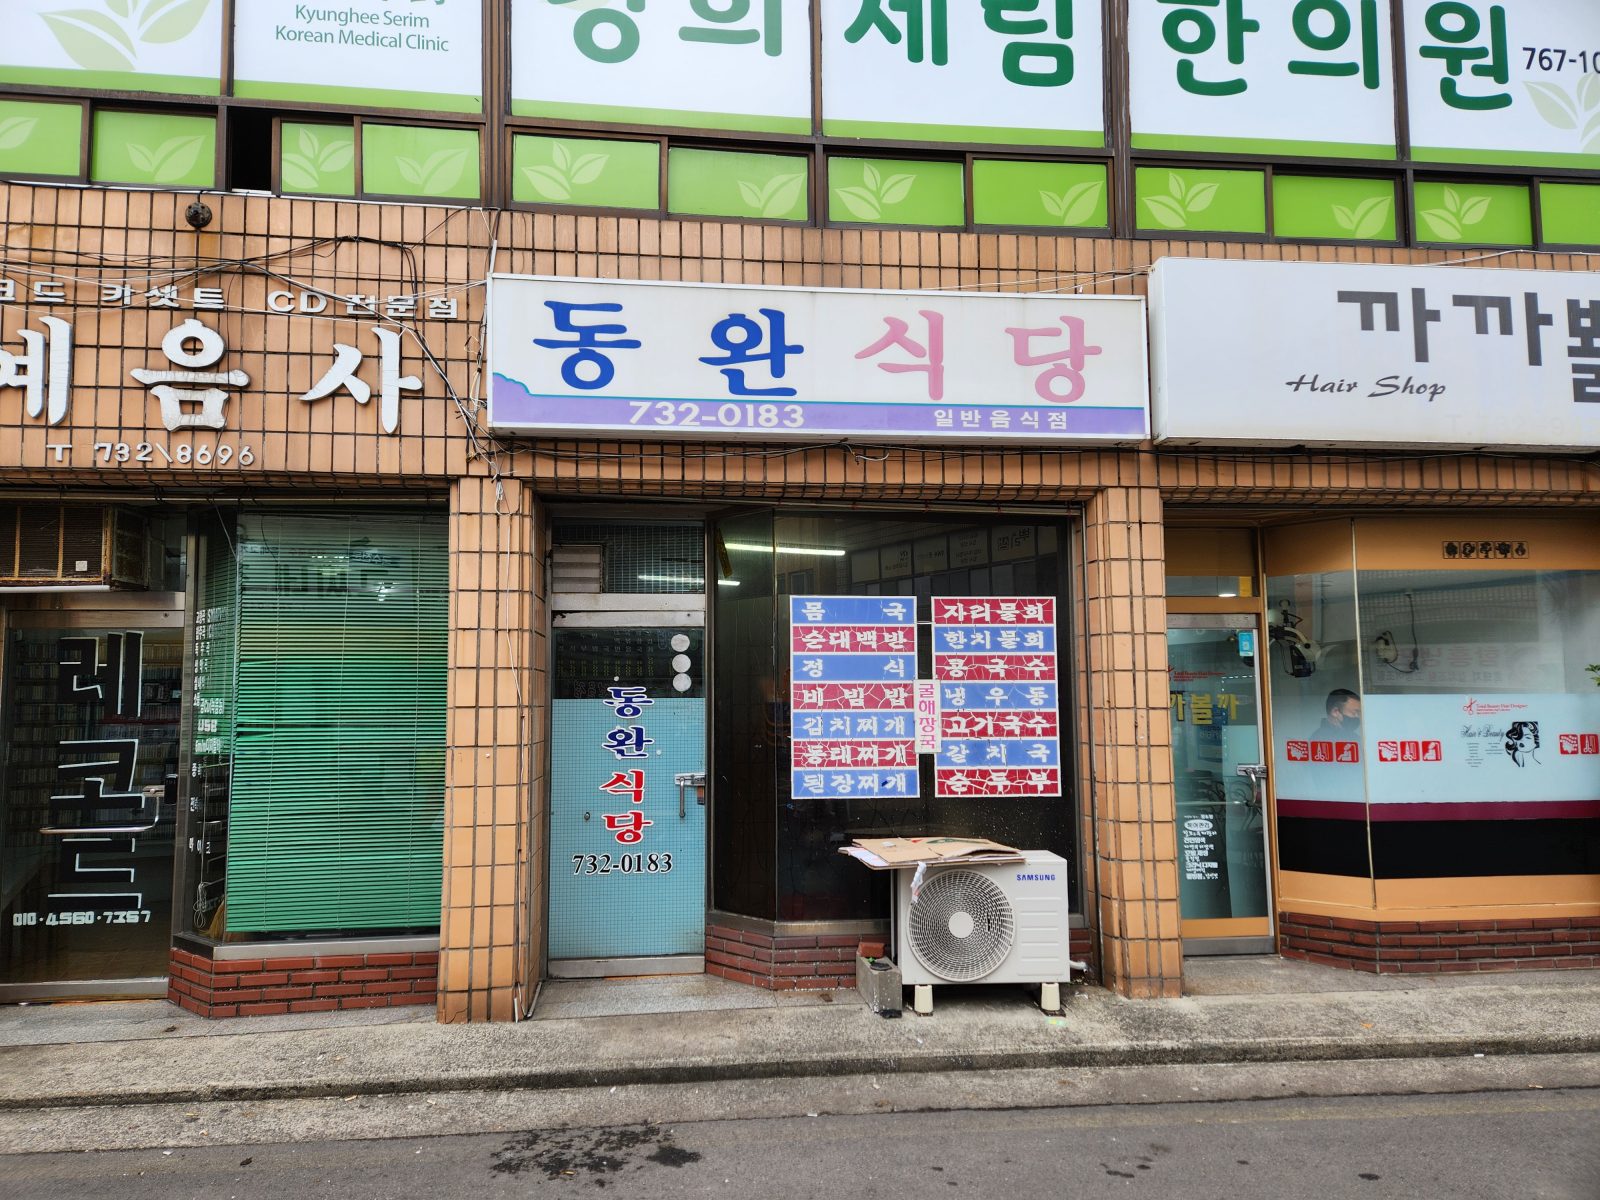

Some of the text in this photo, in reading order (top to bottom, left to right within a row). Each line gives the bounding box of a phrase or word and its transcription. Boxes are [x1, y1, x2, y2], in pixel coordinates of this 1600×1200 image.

[295, 4, 430, 28] Kyunghee Serim
[275, 25, 449, 51] Korean Medical Clinic
[102, 283, 225, 309] 카셋트
[267, 290, 328, 313] CD
[345, 294, 458, 319] 전문점
[1285, 374, 1446, 401] Hair Shop
[629, 401, 1067, 430] 732-0183 일반음식점
[46, 444, 73, 462] T
[943, 602, 1044, 622] 자리물회
[801, 629, 908, 649] 순대백반
[943, 630, 1044, 650] 한치물회
[802, 658, 905, 678] 정식
[943, 658, 1049, 678] 콩국수
[802, 687, 909, 707] 비빔밥
[944, 686, 1049, 706] 냉우동
[943, 715, 1051, 735] 고기국수
[945, 743, 1051, 763] 갈치국
[600, 687, 655, 845] 동완식당
[945, 771, 1052, 792] 순두부
[571, 853, 674, 875] 732-0183
[1016, 874, 1056, 882] SAMSUNG
